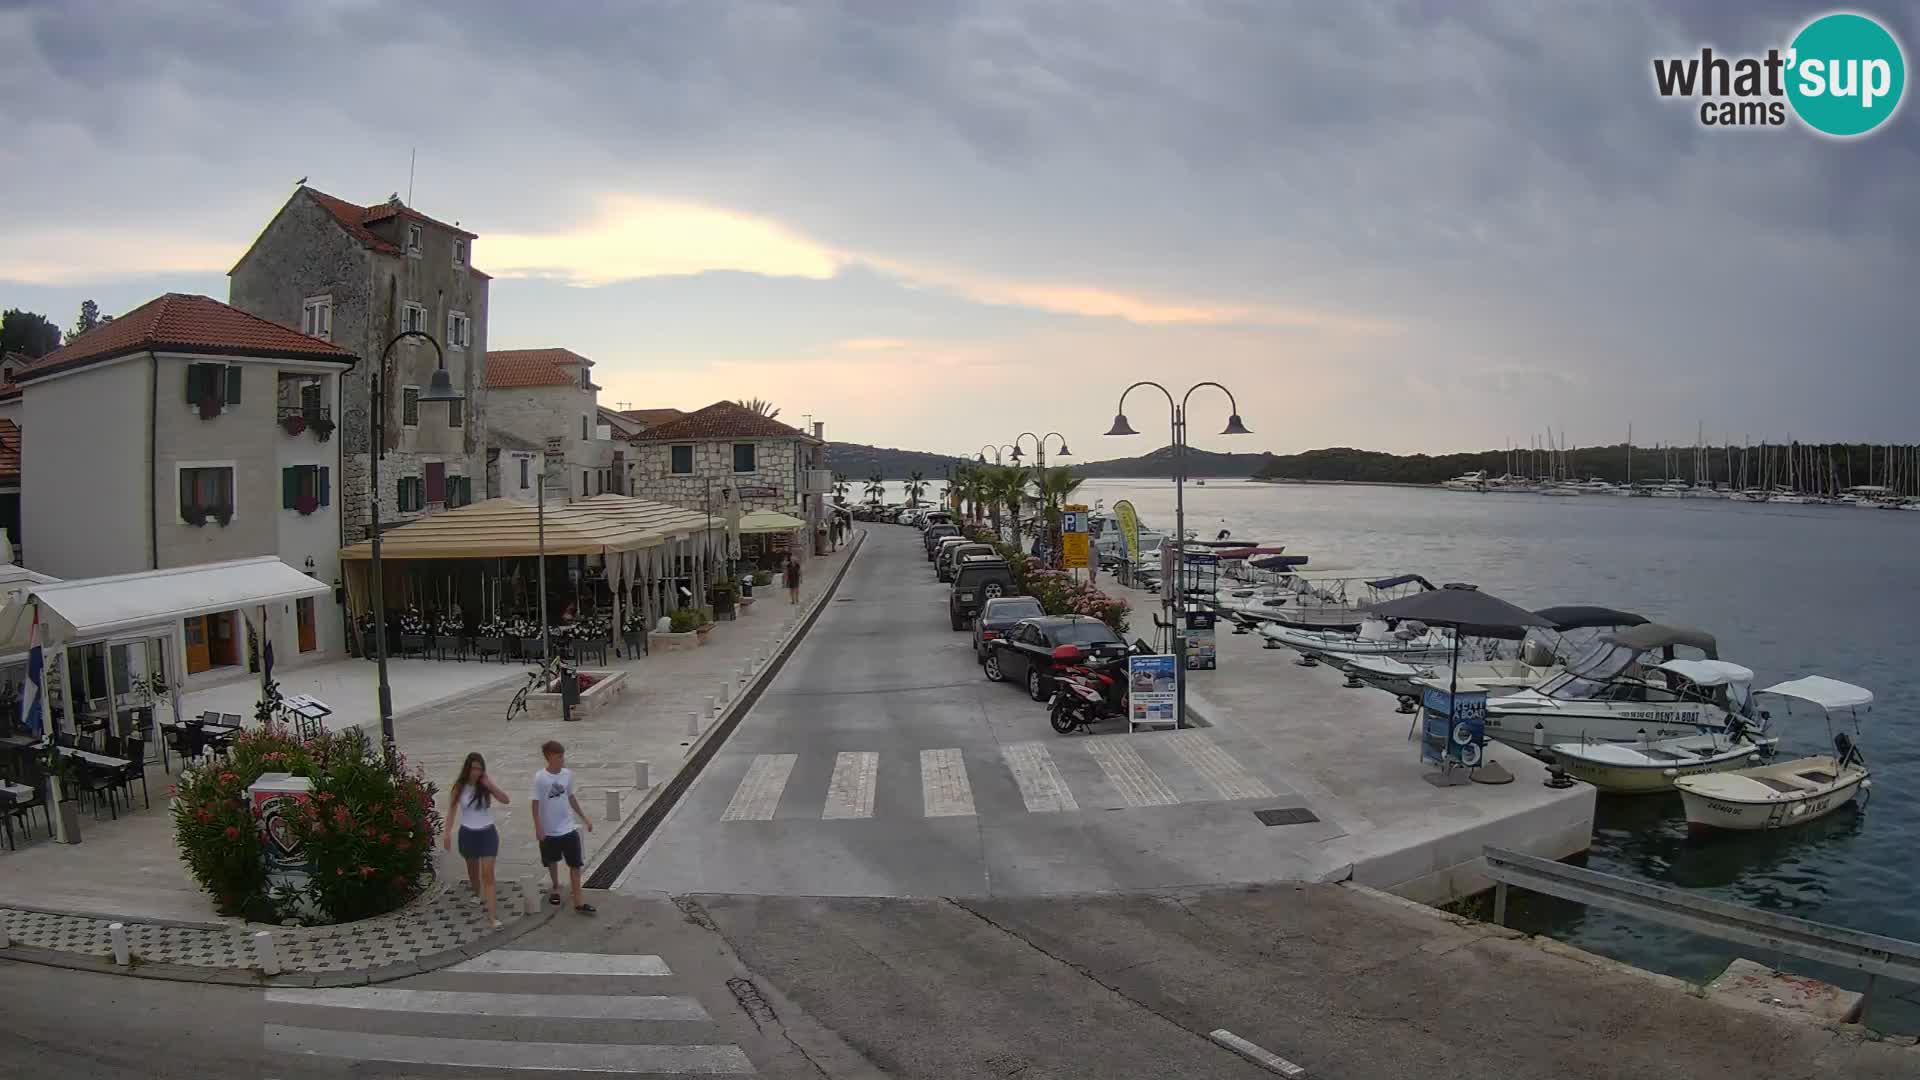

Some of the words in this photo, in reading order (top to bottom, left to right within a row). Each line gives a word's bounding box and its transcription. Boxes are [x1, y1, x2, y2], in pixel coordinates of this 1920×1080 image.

[1064, 514, 1075, 531] P
[1455, 699, 1485, 711] RENT
[1453, 710, 1460, 719] A
[1655, 711, 1674, 721] RENT
[1681, 711, 1700, 722] BOAT
